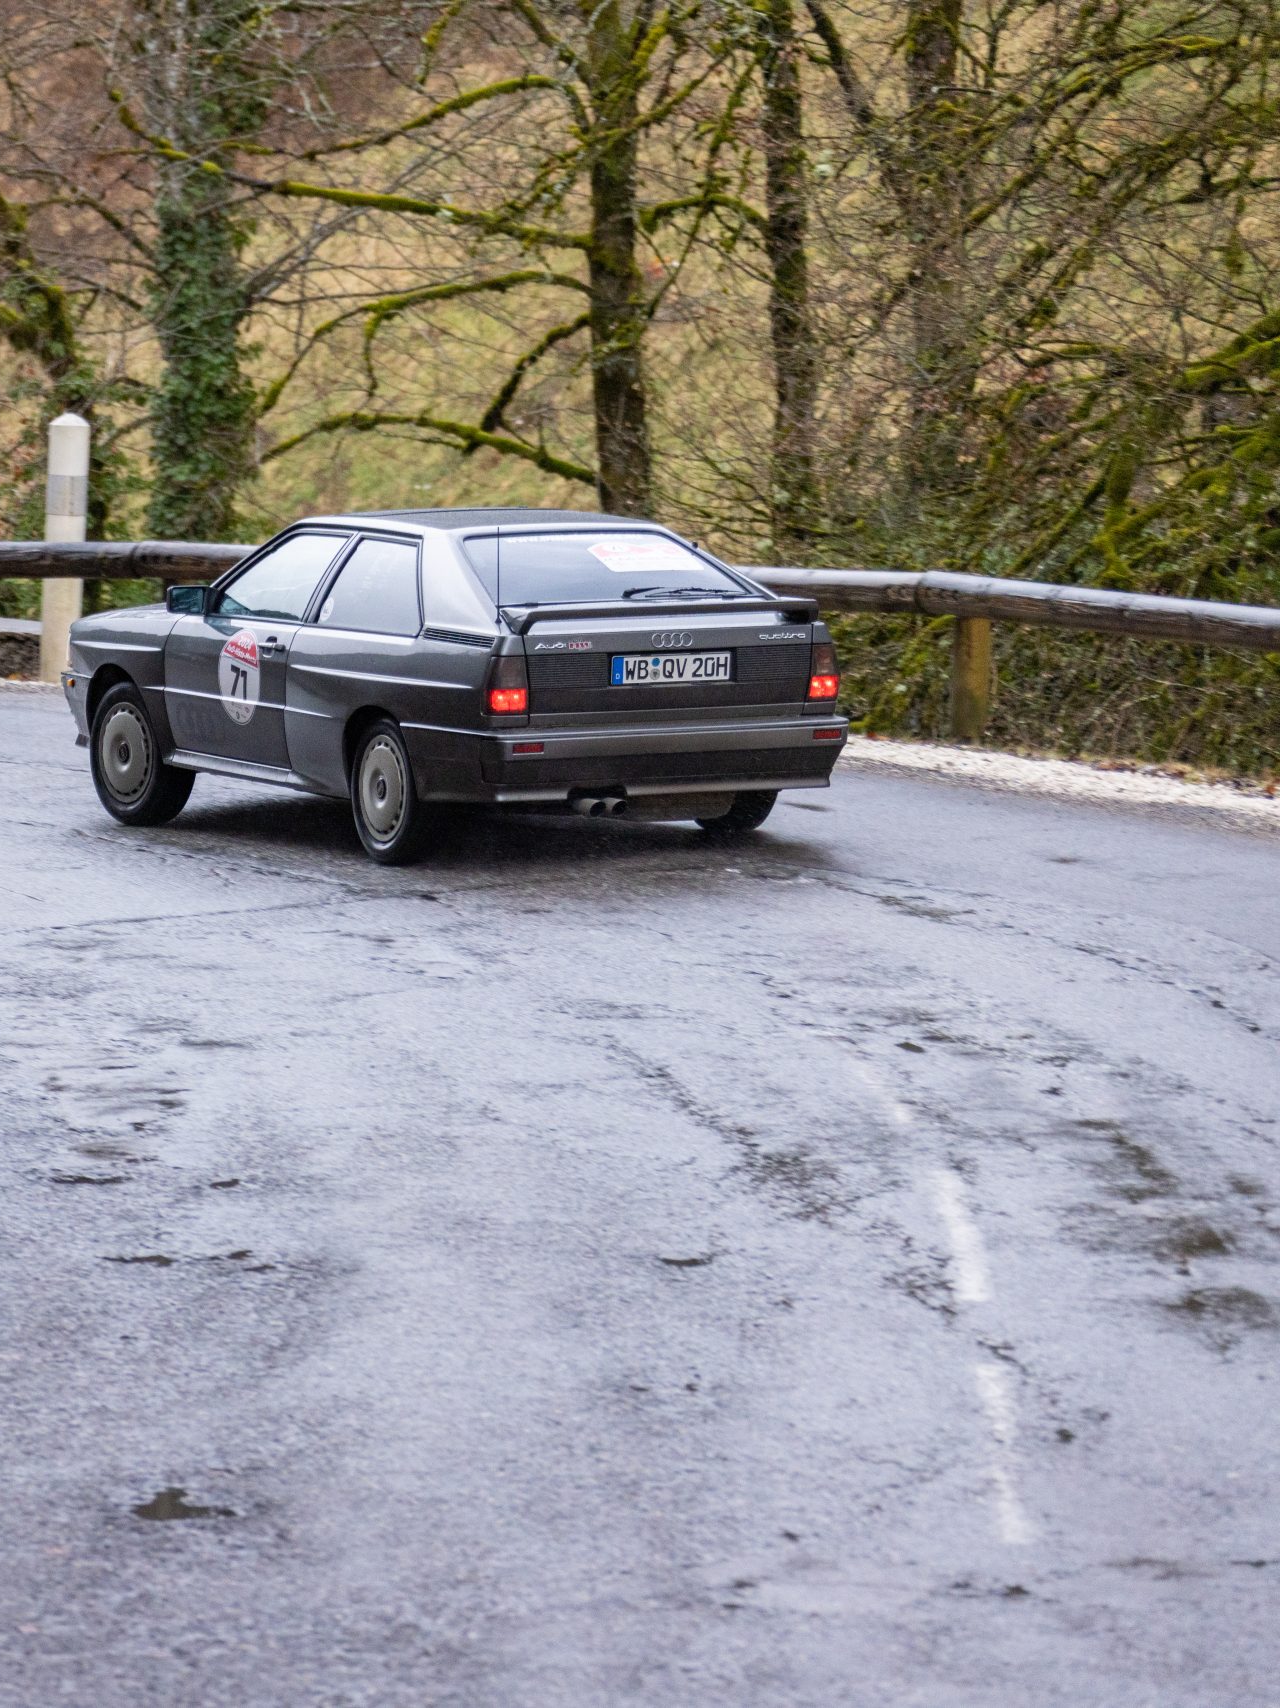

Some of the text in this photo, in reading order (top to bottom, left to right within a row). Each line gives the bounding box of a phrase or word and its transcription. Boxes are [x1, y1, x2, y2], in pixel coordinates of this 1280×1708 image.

[759, 632, 806, 641] quattro
[625, 656, 729, 681] WB QV 20H
[230, 663, 248, 701] 71
